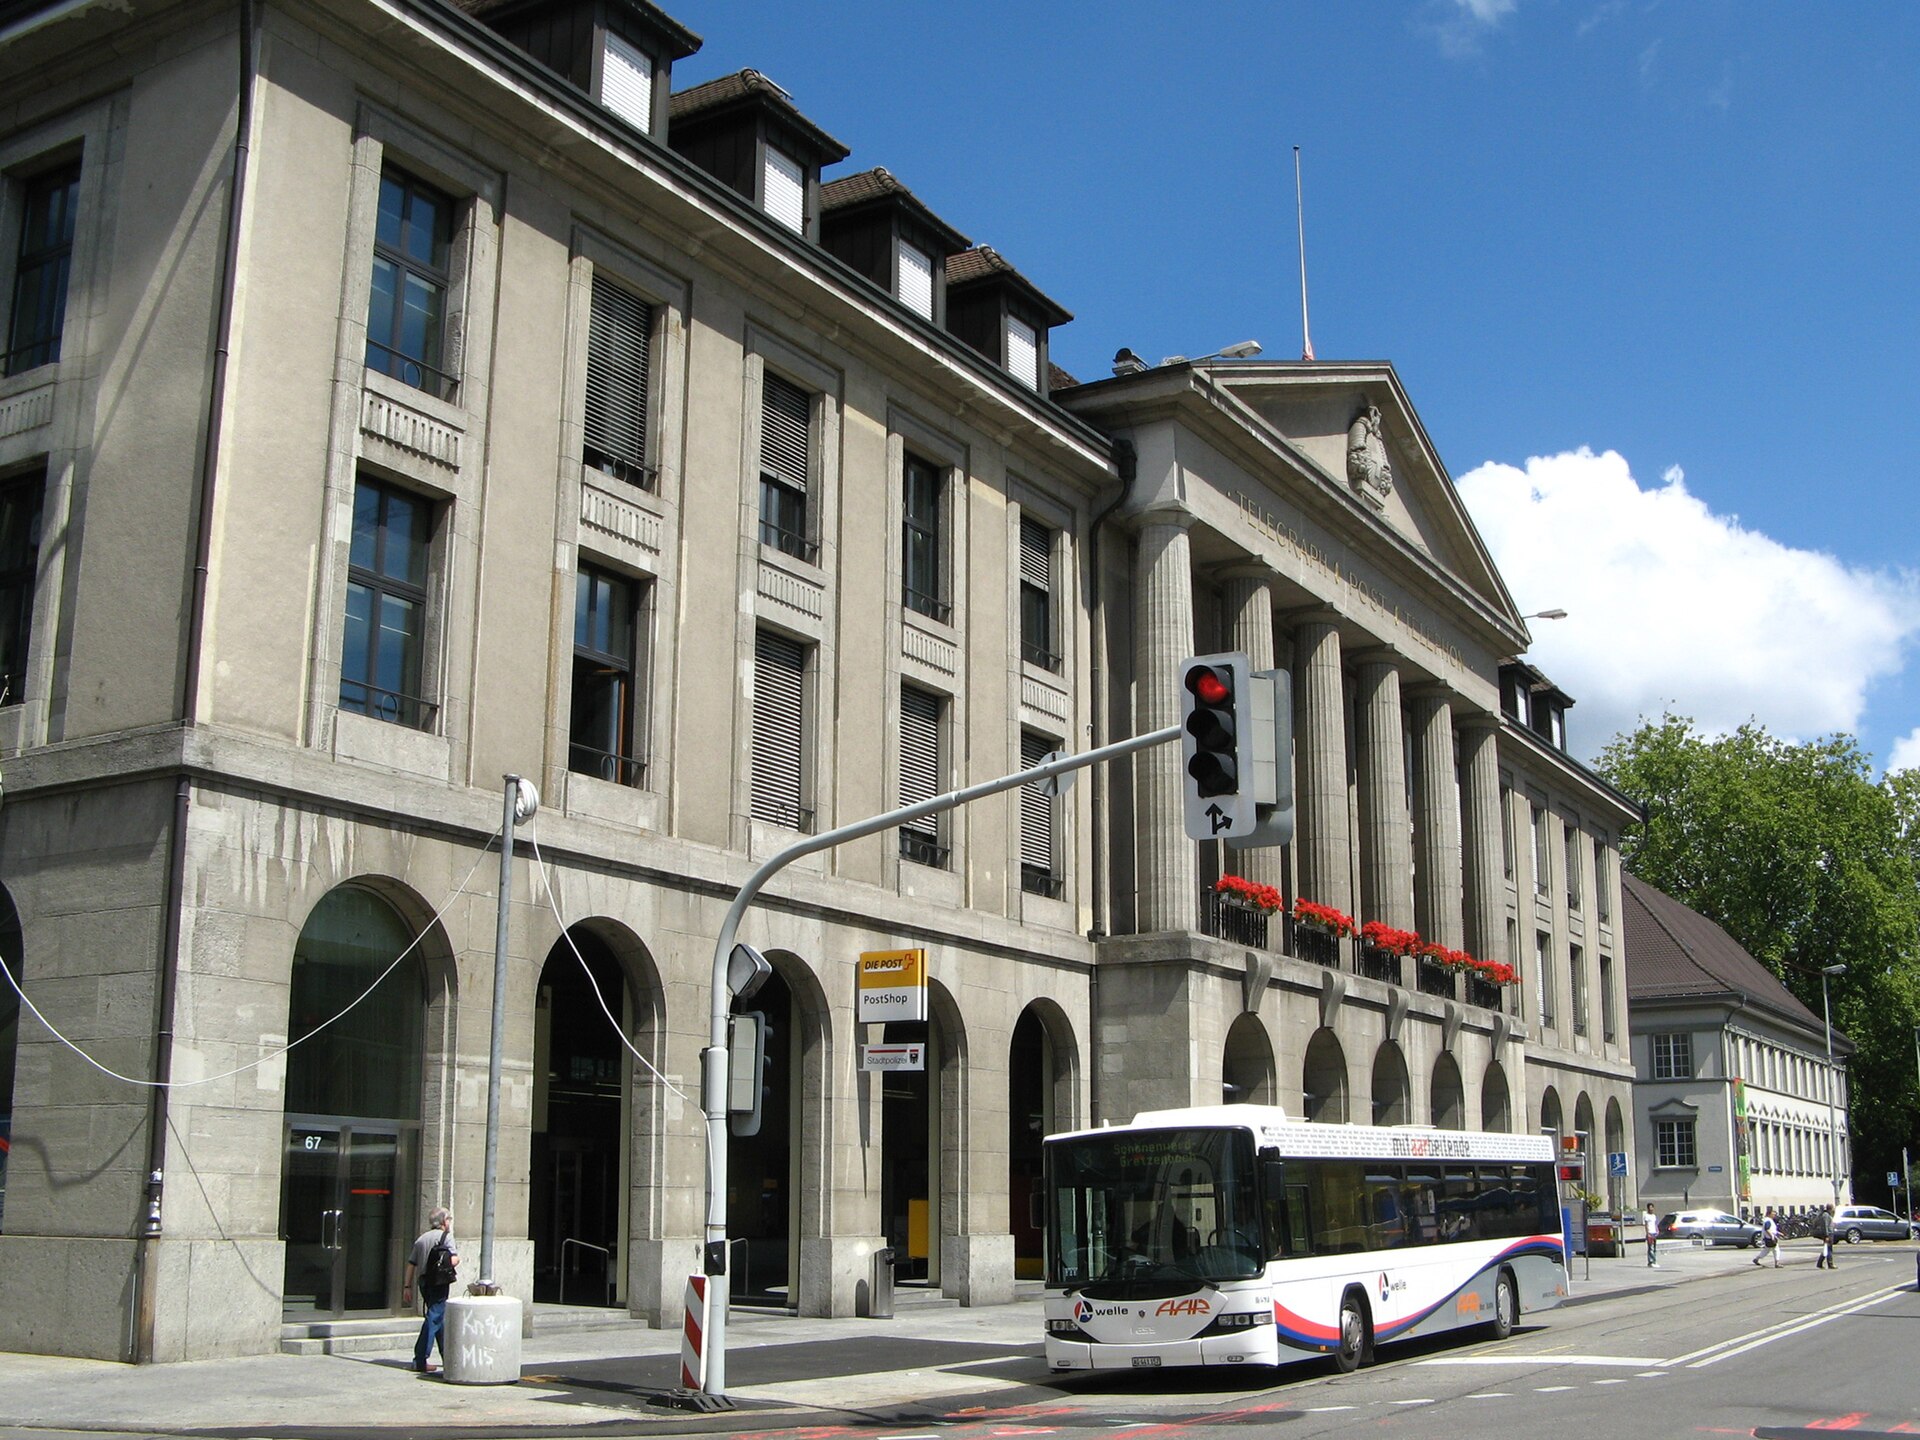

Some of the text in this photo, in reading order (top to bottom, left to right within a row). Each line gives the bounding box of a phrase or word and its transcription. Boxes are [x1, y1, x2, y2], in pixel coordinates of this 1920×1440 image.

[1236, 490, 1328, 579] TELEGRAPH
[1349, 571, 1387, 619] POST
[864, 958, 904, 970] DIE POST
[863, 993, 908, 1005] PostShop
[867, 1056, 908, 1066] Stadtpolizei
[305, 1135, 322, 1150] 67
[1095, 1306, 1129, 1316] welle
[1155, 1299, 1211, 1317] AAR
